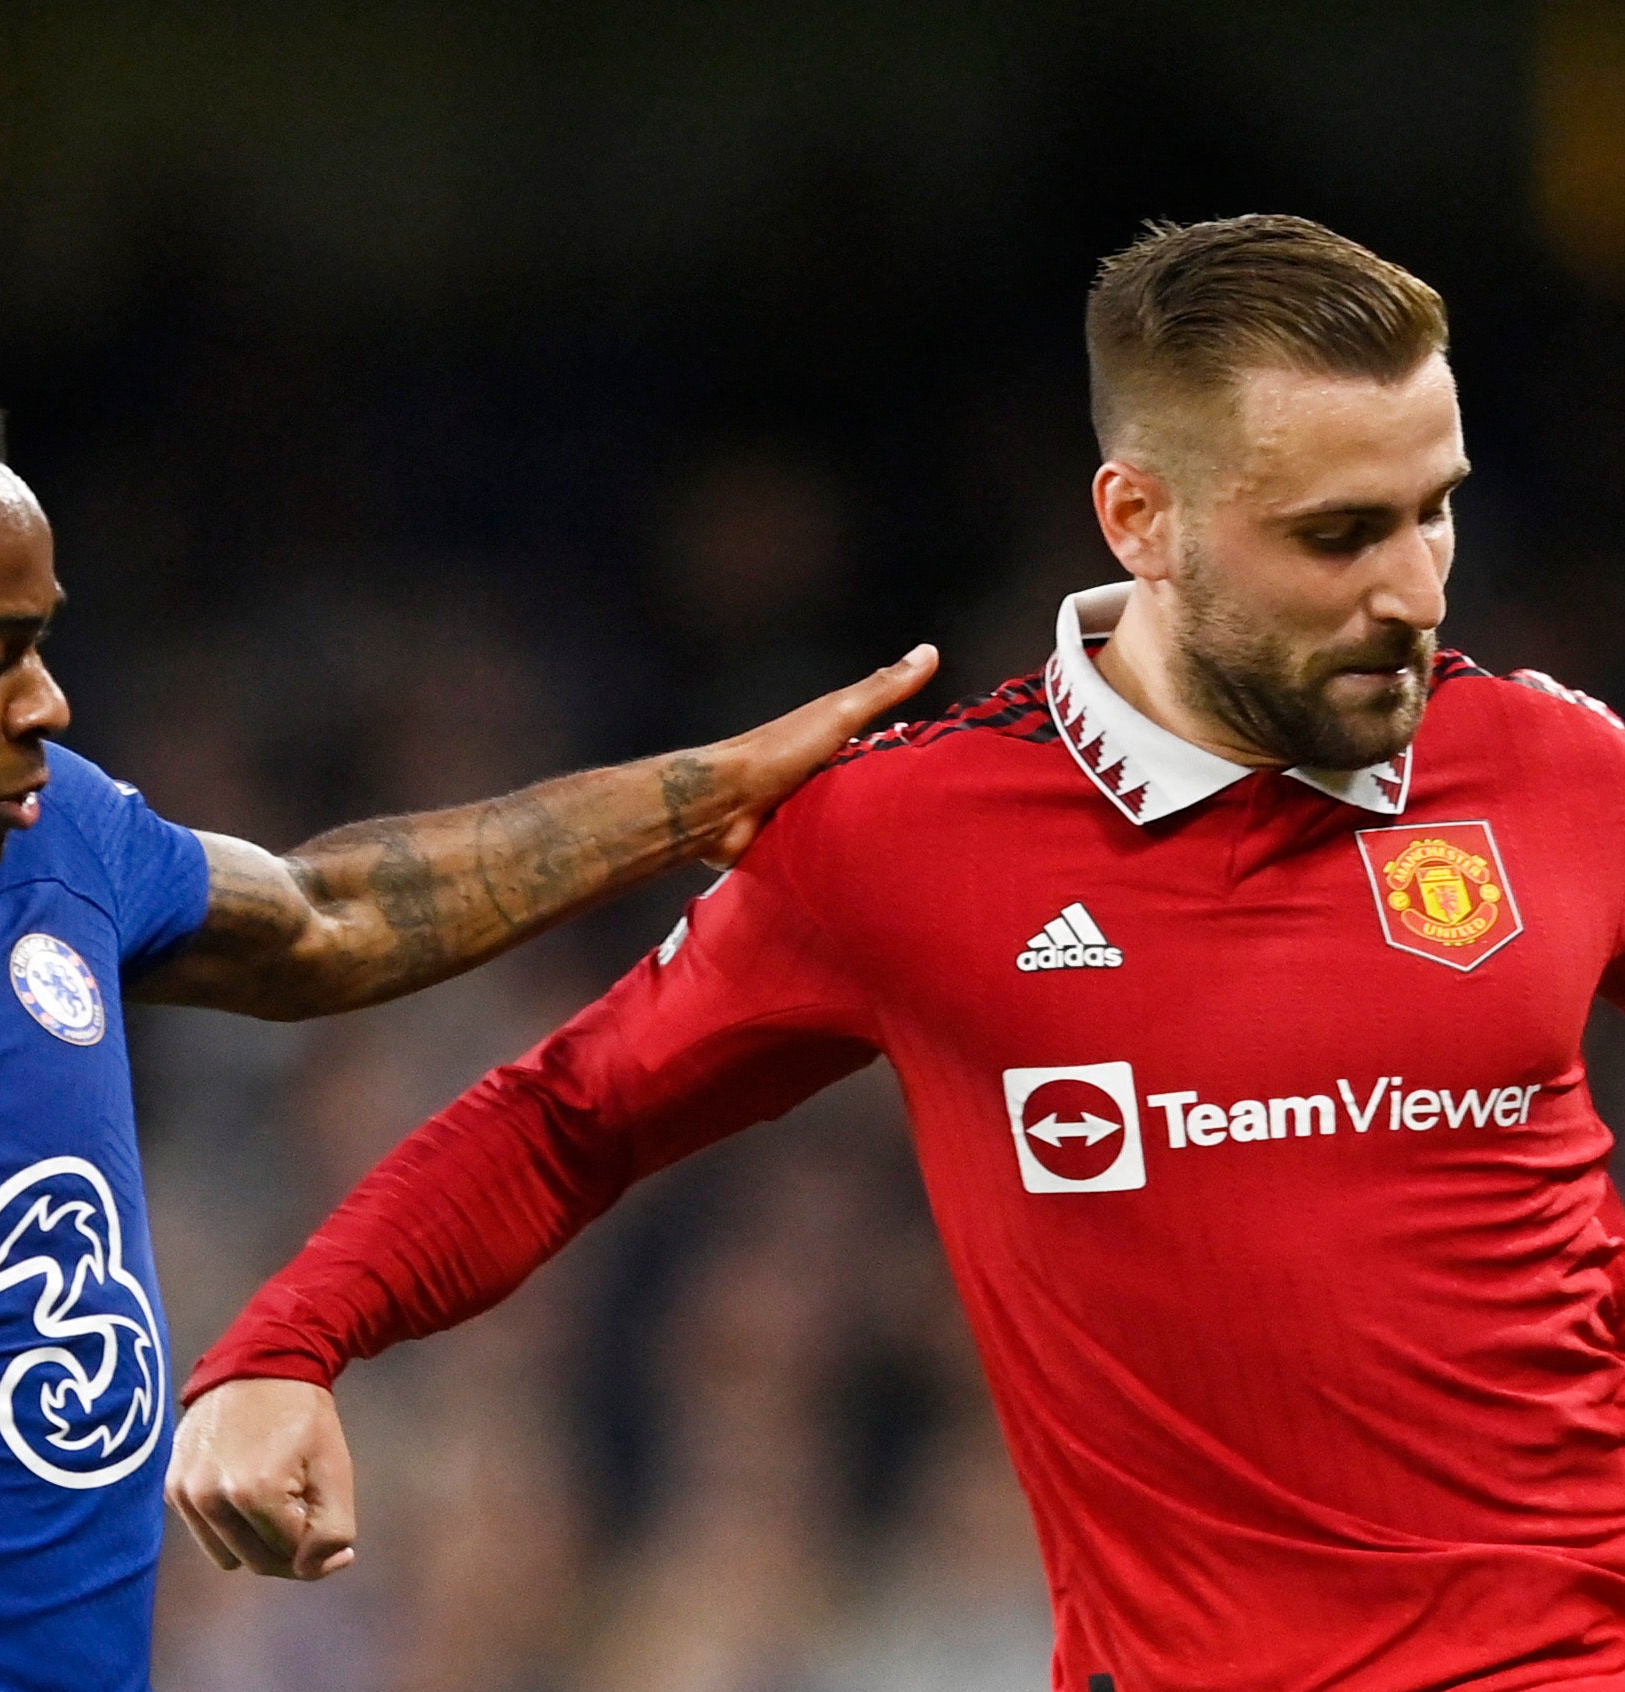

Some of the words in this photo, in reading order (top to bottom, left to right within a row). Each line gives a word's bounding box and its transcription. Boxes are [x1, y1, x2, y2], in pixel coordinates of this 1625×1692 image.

[1394, 846, 1483, 883] MANCHESTER
[1423, 917, 1488, 939] UNITED
[1016, 943, 1124, 973] adidas
[1146, 1075, 1542, 1149] TeamViewer
